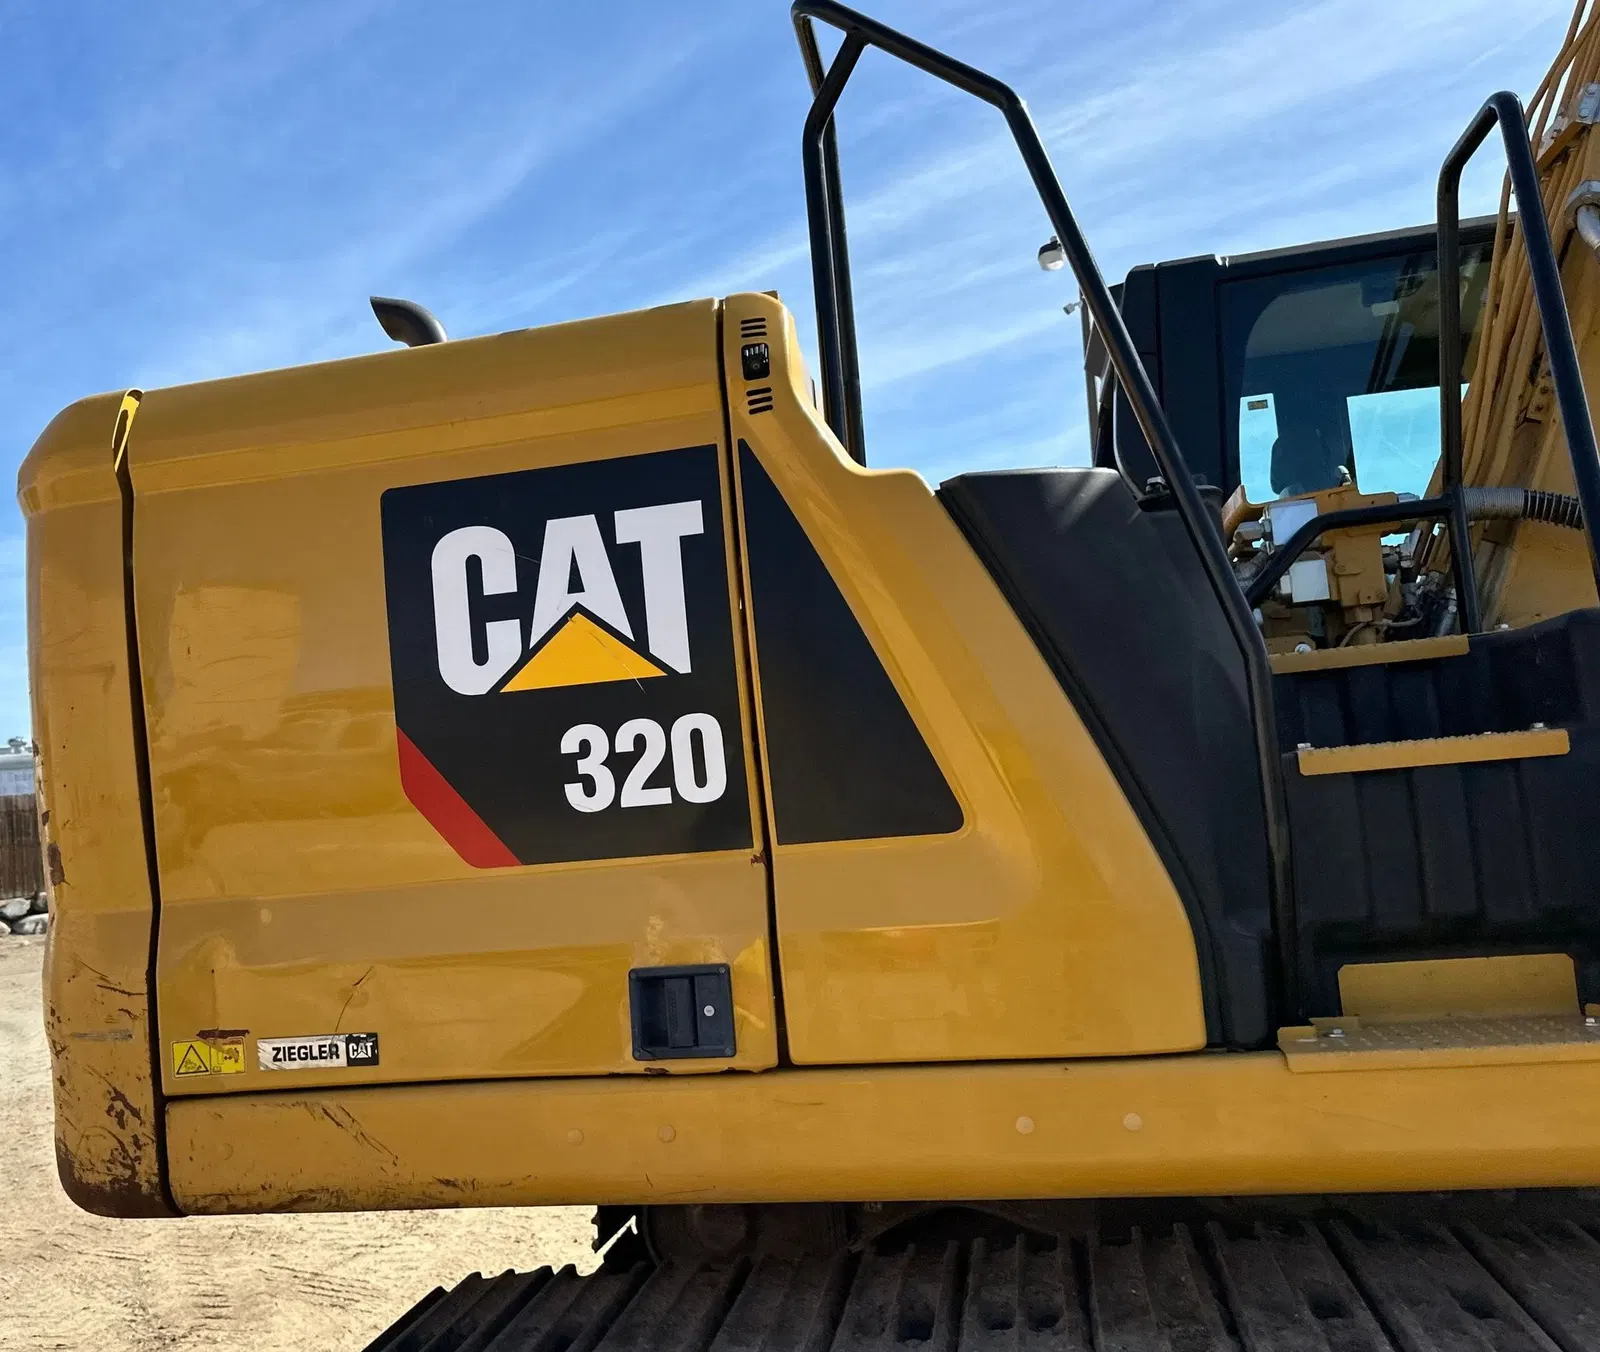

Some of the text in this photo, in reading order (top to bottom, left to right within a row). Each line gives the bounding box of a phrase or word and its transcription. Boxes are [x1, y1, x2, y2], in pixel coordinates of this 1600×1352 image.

[432, 501, 704, 695] CAT
[561, 713, 726, 812] 320
[272, 1042, 373, 1062] ZIEGLER CAT
